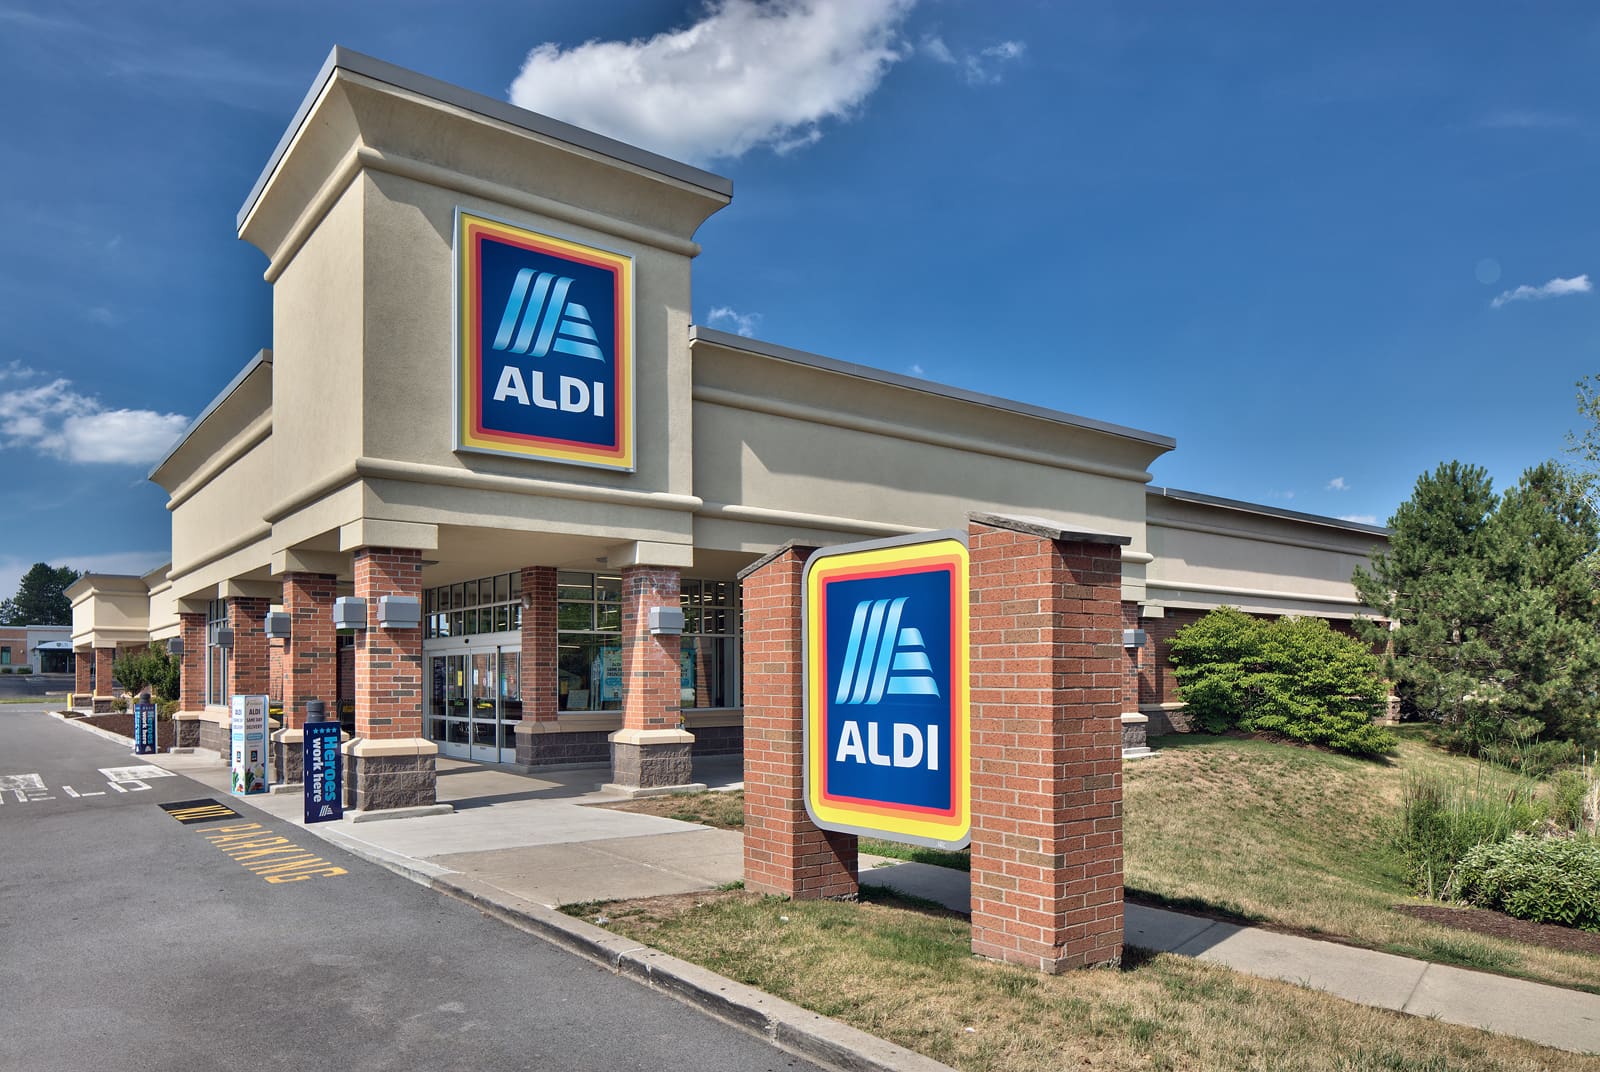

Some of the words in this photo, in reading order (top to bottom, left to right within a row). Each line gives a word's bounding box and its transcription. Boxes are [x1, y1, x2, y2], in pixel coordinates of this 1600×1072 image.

[493, 365, 604, 417] ALDI
[312, 737, 324, 771] work
[323, 735, 338, 802] Heroes
[835, 720, 939, 771] ALDI
[166, 804, 236, 820] NO
[312, 773, 324, 803] here
[195, 822, 349, 884] PARKING
